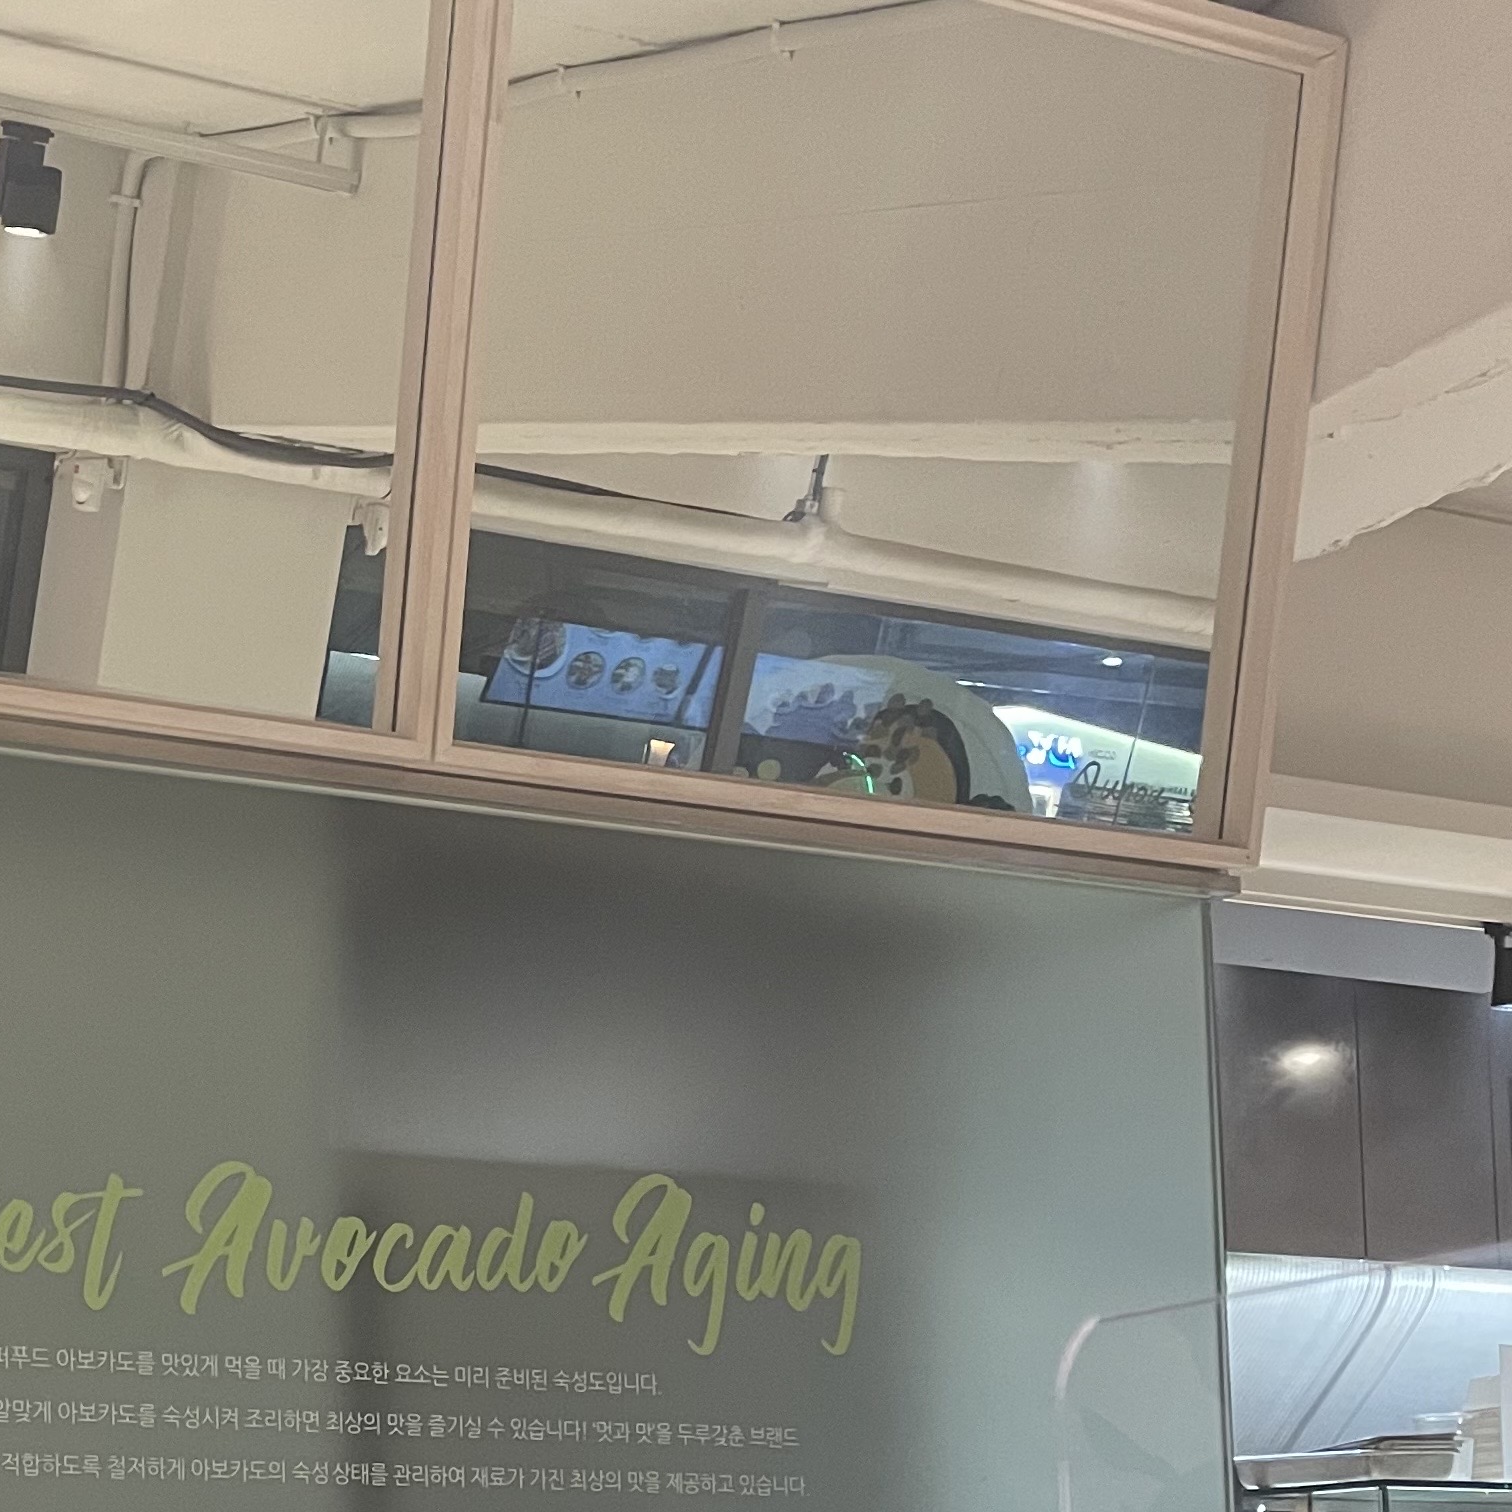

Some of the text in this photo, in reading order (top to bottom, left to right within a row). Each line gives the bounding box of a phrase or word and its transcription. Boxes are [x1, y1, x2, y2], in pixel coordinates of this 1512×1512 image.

[160, 1161, 588, 1315] Avocado
[590, 1173, 863, 1356] Aging
[56, 1349, 156, 1376] 아보카도를
[161, 1353, 218, 1377] 맛있게
[267, 1357, 286, 1380] 때
[291, 1359, 329, 1383] 가장
[334, 1360, 389, 1385] 중요한
[394, 1364, 449, 1387] 요소는
[454, 1366, 489, 1388] 미리
[494, 1367, 548, 1391] 준비된
[58, 1402, 157, 1428] 아보카도를
[162, 1405, 239, 1430] 숙성시켜
[244, 1408, 320, 1433] 조리하면
[326, 1411, 381, 1436] 최상의
[388, 1413, 423, 1437] 맛을
[428, 1414, 482, 1439] 즐기실
[487, 1416, 506, 1439] 수
[510, 1417, 587, 1443] 있습니다!
[677, 1424, 746, 1447] 두루갖춘
[748, 1426, 800, 1448] 브랜드
[1, 1453, 103, 1479] 적합하도록
[107, 1455, 185, 1481] 철저하게
[191, 1458, 286, 1483] 아보카도의
[392, 1464, 465, 1488] 관리하여
[470, 1466, 525, 1490] 재료가
[530, 1467, 565, 1491] 가진
[570, 1469, 621, 1492] 최상의
[628, 1470, 661, 1494] 맛을
[666, 1472, 735, 1495] 제공하고
